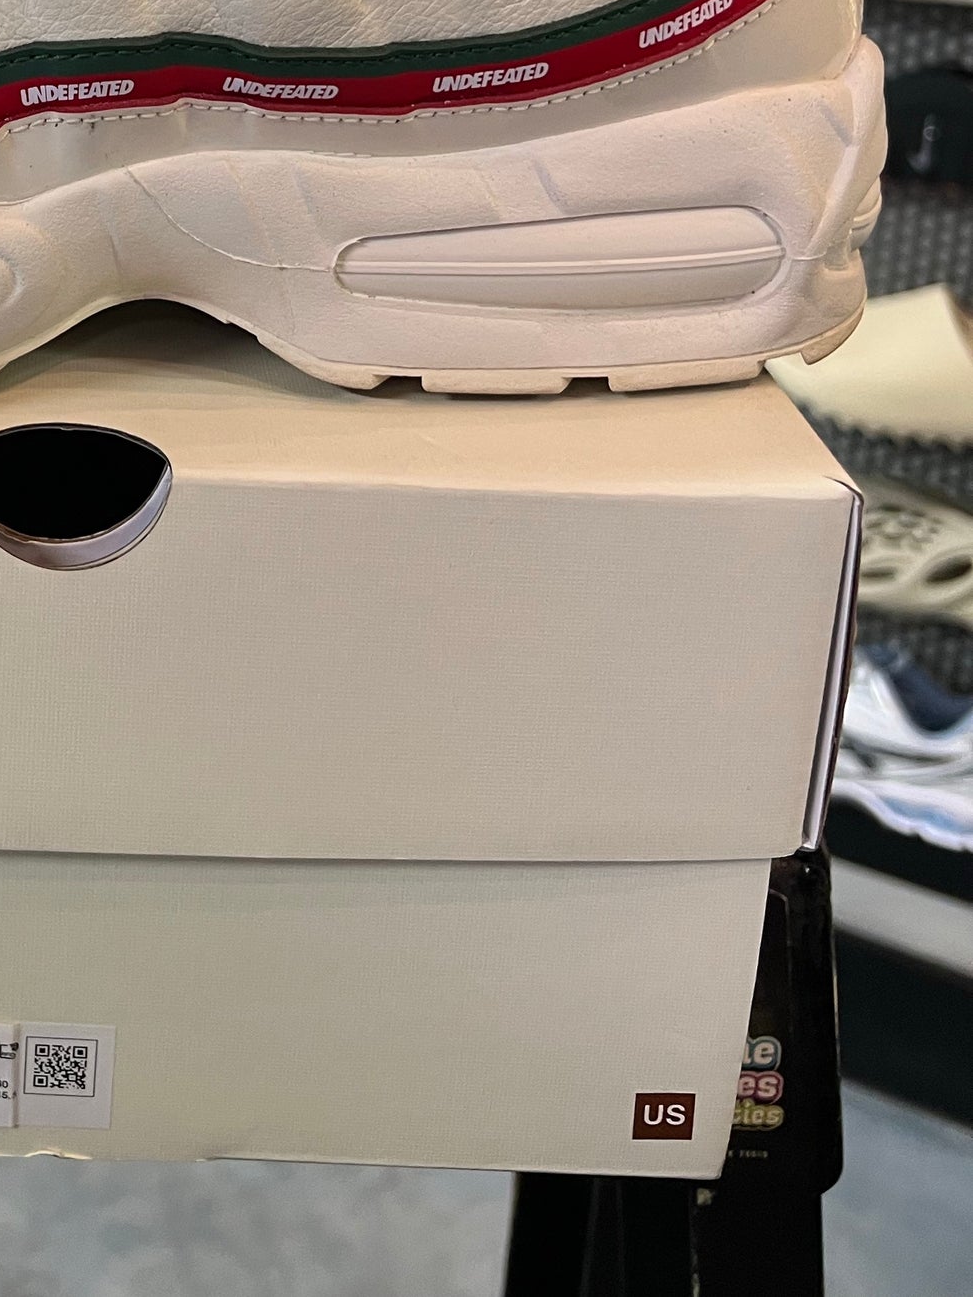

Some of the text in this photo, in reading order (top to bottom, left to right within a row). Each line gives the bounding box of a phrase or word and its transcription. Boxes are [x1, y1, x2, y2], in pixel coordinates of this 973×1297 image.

[222, 77, 339, 99] UNDEFEATED
[432, 62, 549, 93] UNDEFEATED
[20, 79, 135, 106] UNDEFEATED
[643, 1104, 686, 1126] US
